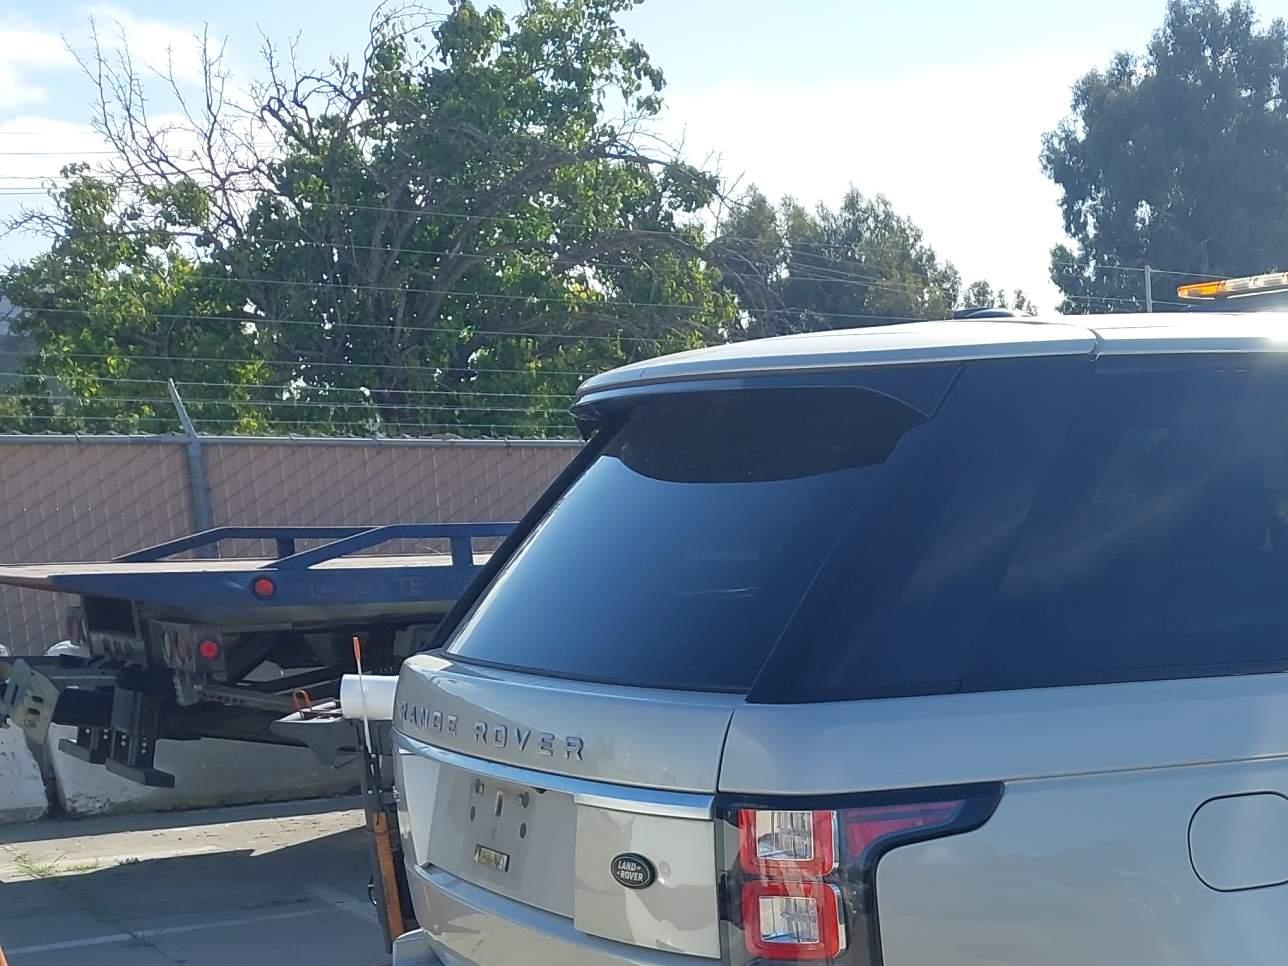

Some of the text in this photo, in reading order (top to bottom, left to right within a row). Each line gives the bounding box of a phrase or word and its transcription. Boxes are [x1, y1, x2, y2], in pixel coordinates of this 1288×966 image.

[473, 720, 585, 761] ROVER
[617, 860, 637, 871] LAND
[620, 870, 644, 882] ROVER
